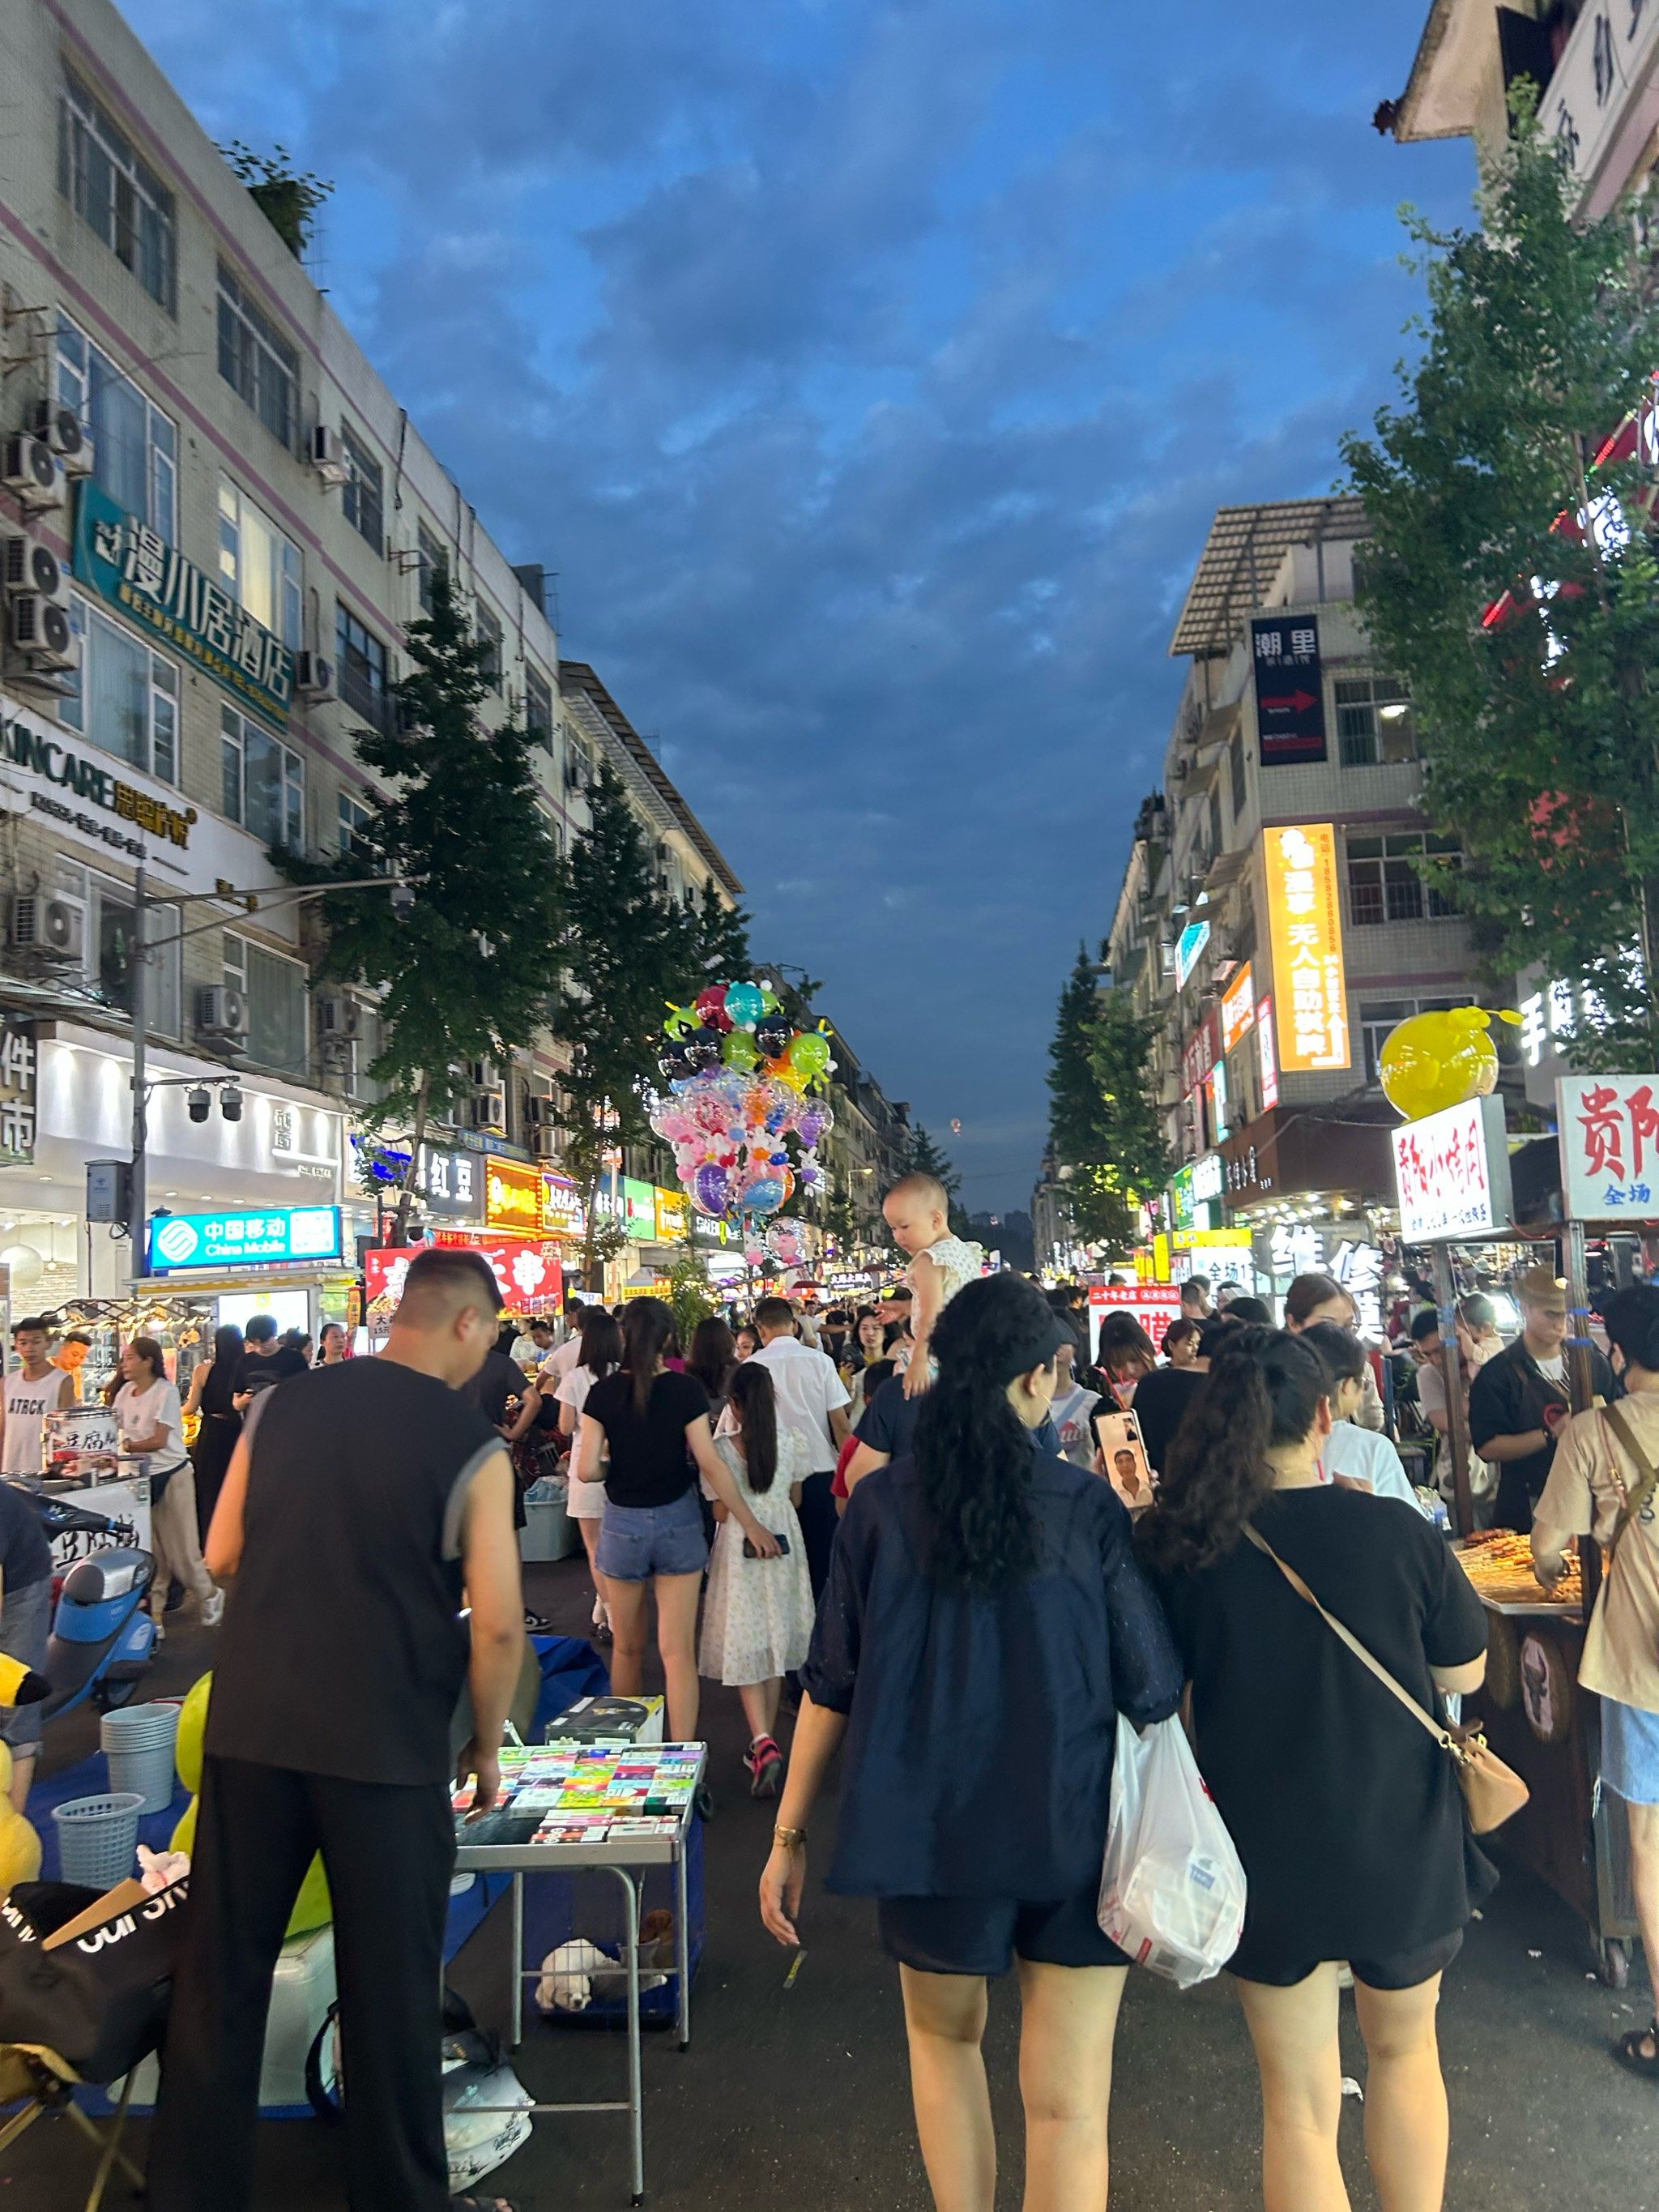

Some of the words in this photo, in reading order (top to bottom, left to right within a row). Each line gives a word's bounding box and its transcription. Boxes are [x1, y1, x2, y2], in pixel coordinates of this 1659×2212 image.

[1254, 629, 1316, 657] 潮里
[430, 1152, 473, 1202] 红豆
[1604, 1183, 1651, 1206] 全场
[205, 1217, 286, 1241] 中国移动
[205, 1243, 242, 1257] China
[244, 1239, 286, 1254] Mobile
[1269, 1224, 1385, 1294] 维修
[8, 1398, 45, 1415] ATRCK
